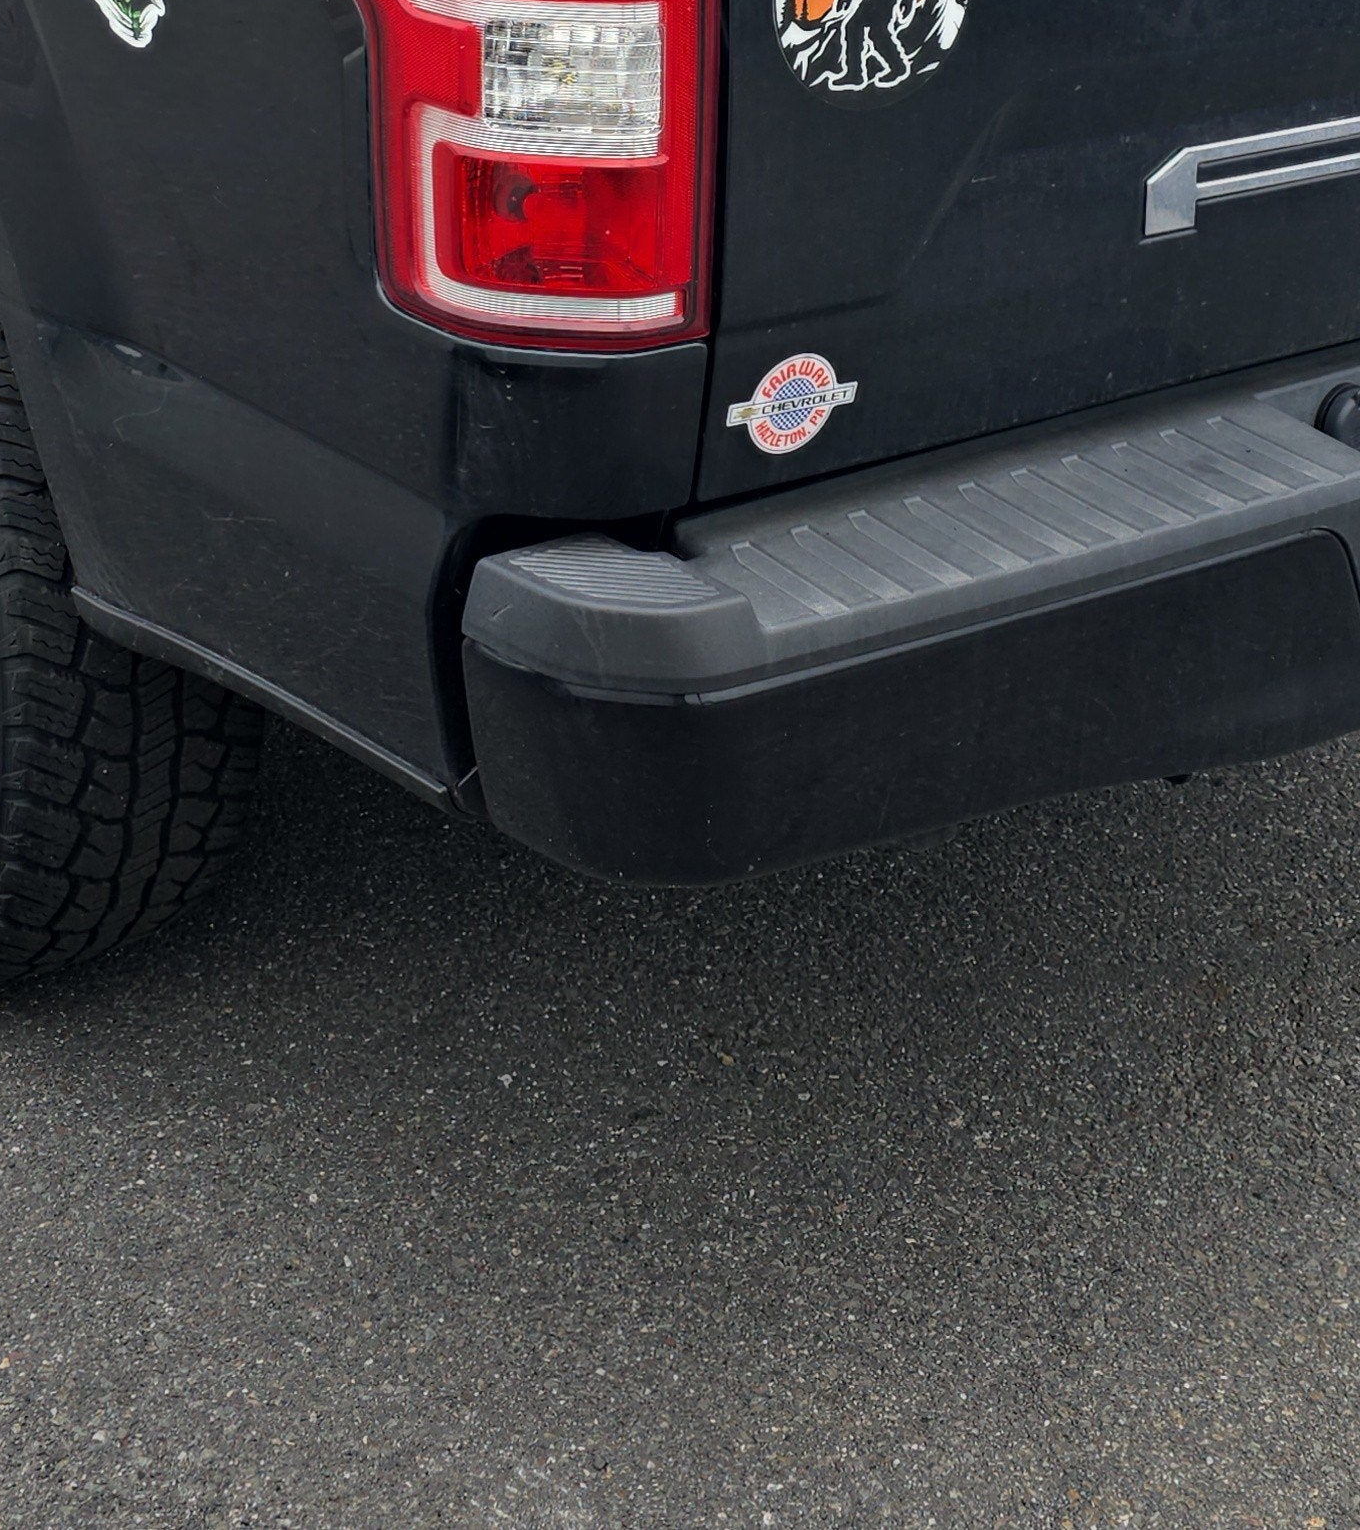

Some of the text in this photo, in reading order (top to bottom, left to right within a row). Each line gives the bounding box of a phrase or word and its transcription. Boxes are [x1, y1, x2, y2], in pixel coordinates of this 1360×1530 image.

[762, 360, 831, 399] FAIRWAY
[762, 390, 848, 414] CHEVROLET
[809, 408, 826, 427] PA
